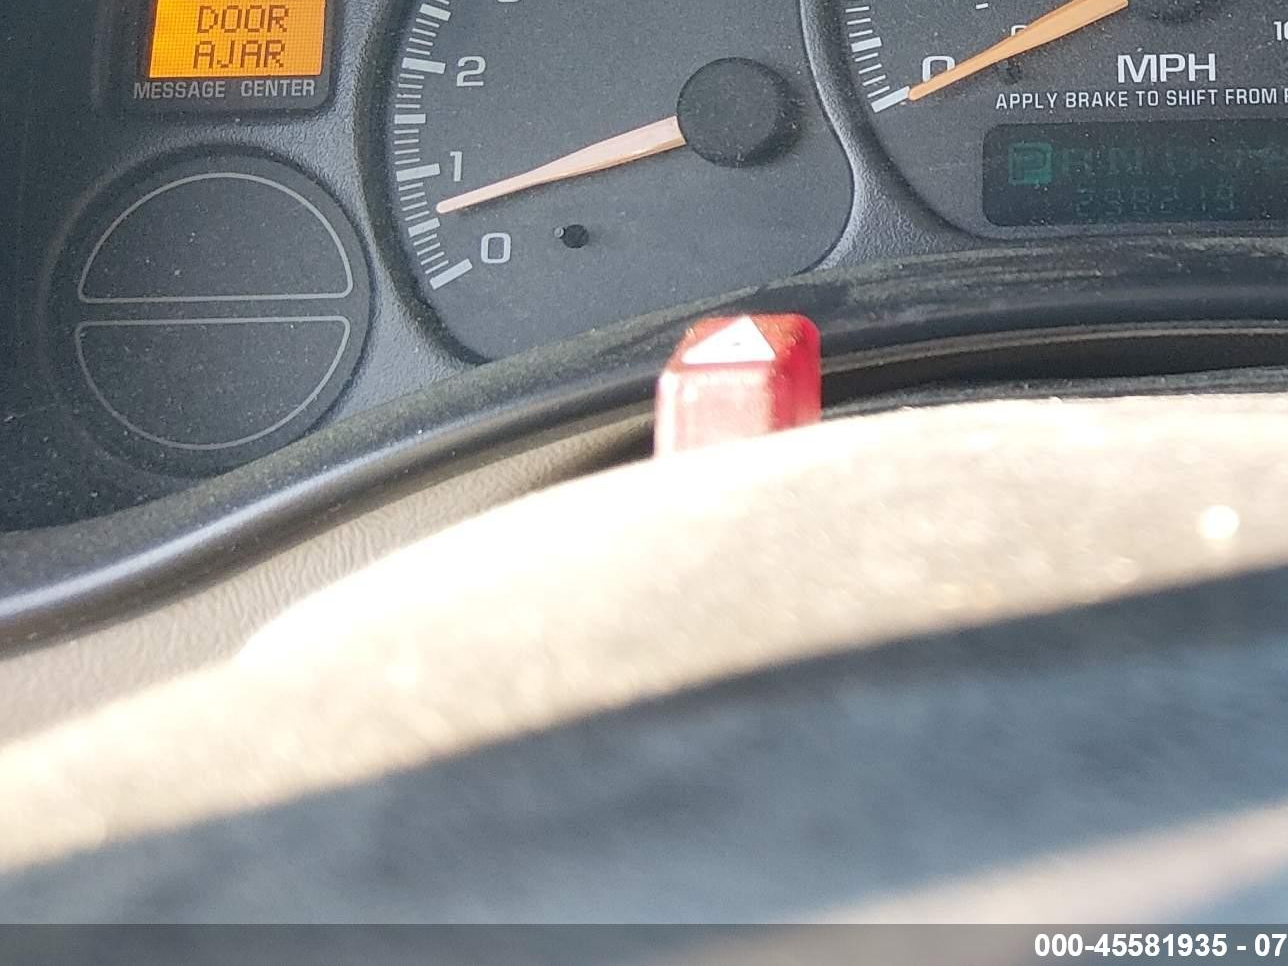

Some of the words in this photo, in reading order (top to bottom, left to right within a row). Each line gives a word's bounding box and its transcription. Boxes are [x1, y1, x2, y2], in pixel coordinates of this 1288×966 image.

[197, 5, 289, 34] DOOR
[193, 40, 285, 69] AJAR
[1118, 54, 1215, 82] MPH
[457, 57, 485, 86] 2
[133, 81, 226, 99] MESSAGE
[241, 80, 315, 97] CENTER
[996, 93, 1057, 109] APPLY
[1066, 91, 1127, 107] BRAKE
[1136, 91, 1158, 106] TO
[1167, 90, 1217, 105] SHIFT
[1226, 89, 1276, 104] FROM
[450, 151, 462, 181] 1
[481, 233, 511, 263] 0
